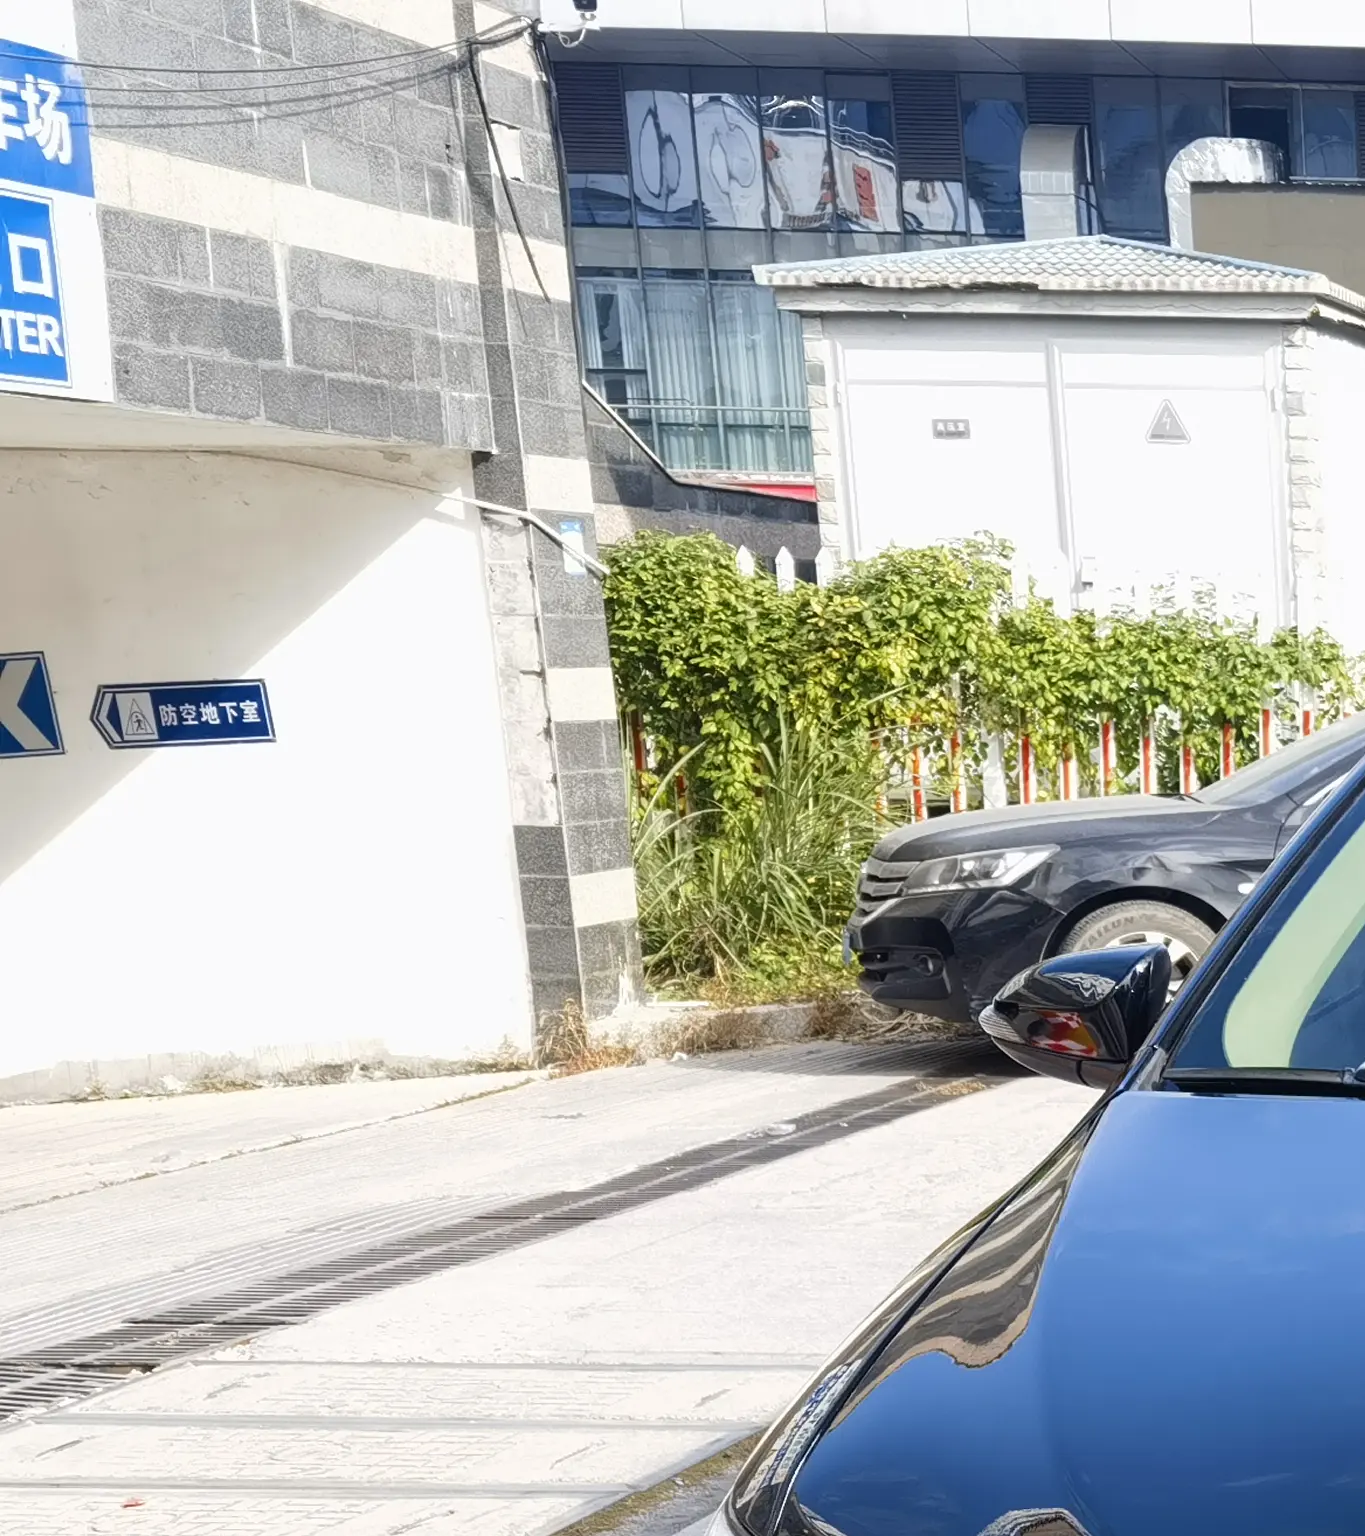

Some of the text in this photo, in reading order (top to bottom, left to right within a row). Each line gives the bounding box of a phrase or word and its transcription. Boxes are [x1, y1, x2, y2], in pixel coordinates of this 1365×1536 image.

[159, 700, 261, 727] 防空地下室
